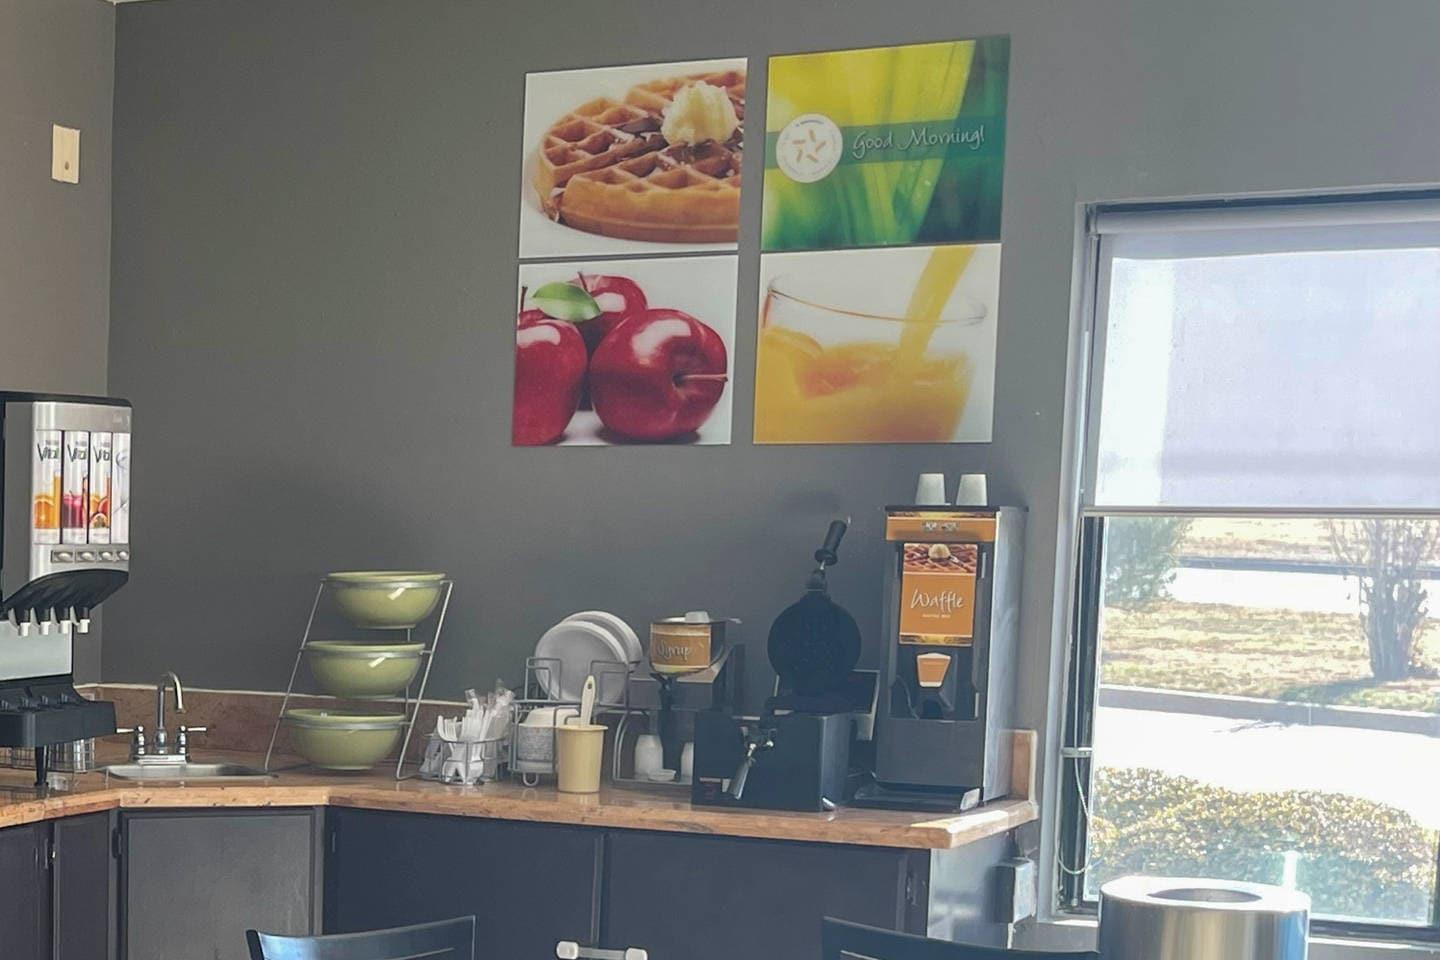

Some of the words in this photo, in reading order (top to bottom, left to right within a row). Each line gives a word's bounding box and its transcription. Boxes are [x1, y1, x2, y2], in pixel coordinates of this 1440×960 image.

[852, 130, 893, 160] Good
[897, 124, 985, 151] Morning!
[910, 588, 964, 613] Waffle
[656, 640, 690, 662] Syrup
